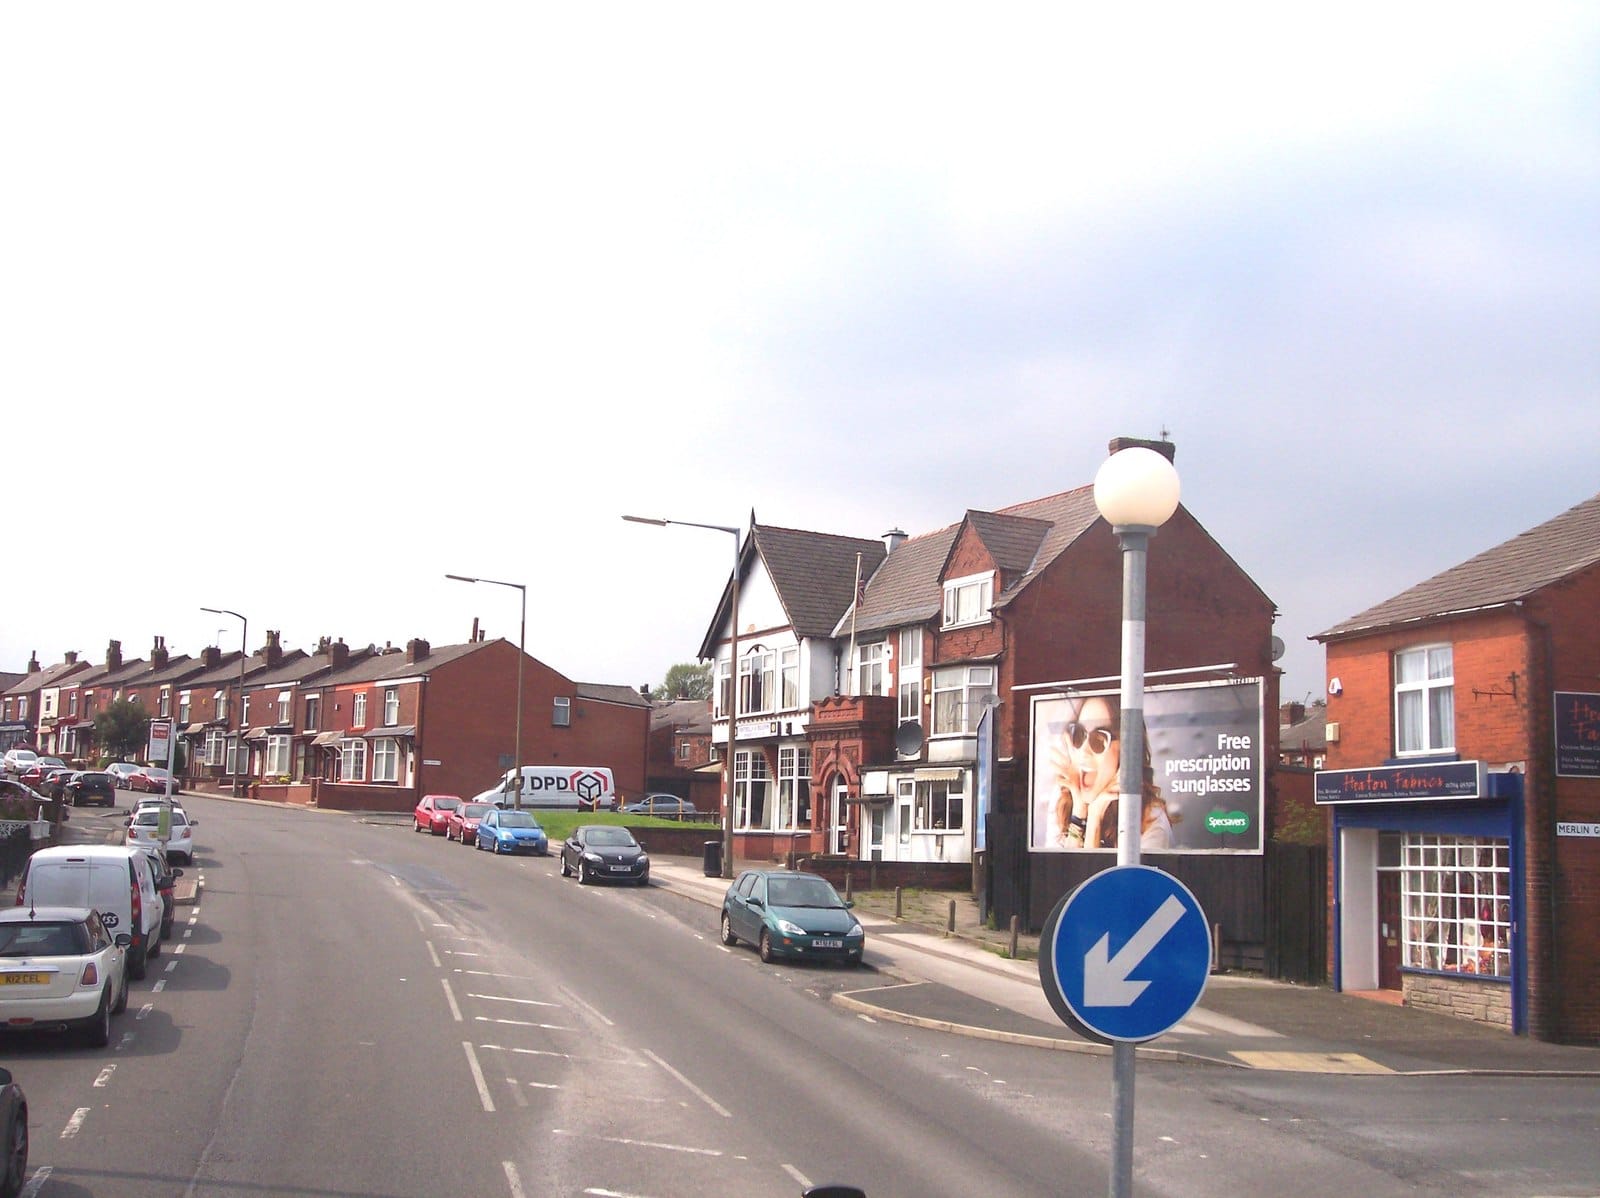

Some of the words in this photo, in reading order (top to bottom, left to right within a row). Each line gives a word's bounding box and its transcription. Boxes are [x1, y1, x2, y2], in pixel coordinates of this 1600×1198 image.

[1217, 733, 1251, 750] Free
[1165, 754, 1250, 776] prescription
[530, 776, 568, 790] DPD
[1171, 775, 1251, 796] sunglasses
[1208, 816, 1246, 828] Specsavers
[1558, 824, 1590, 834] MERLIN
